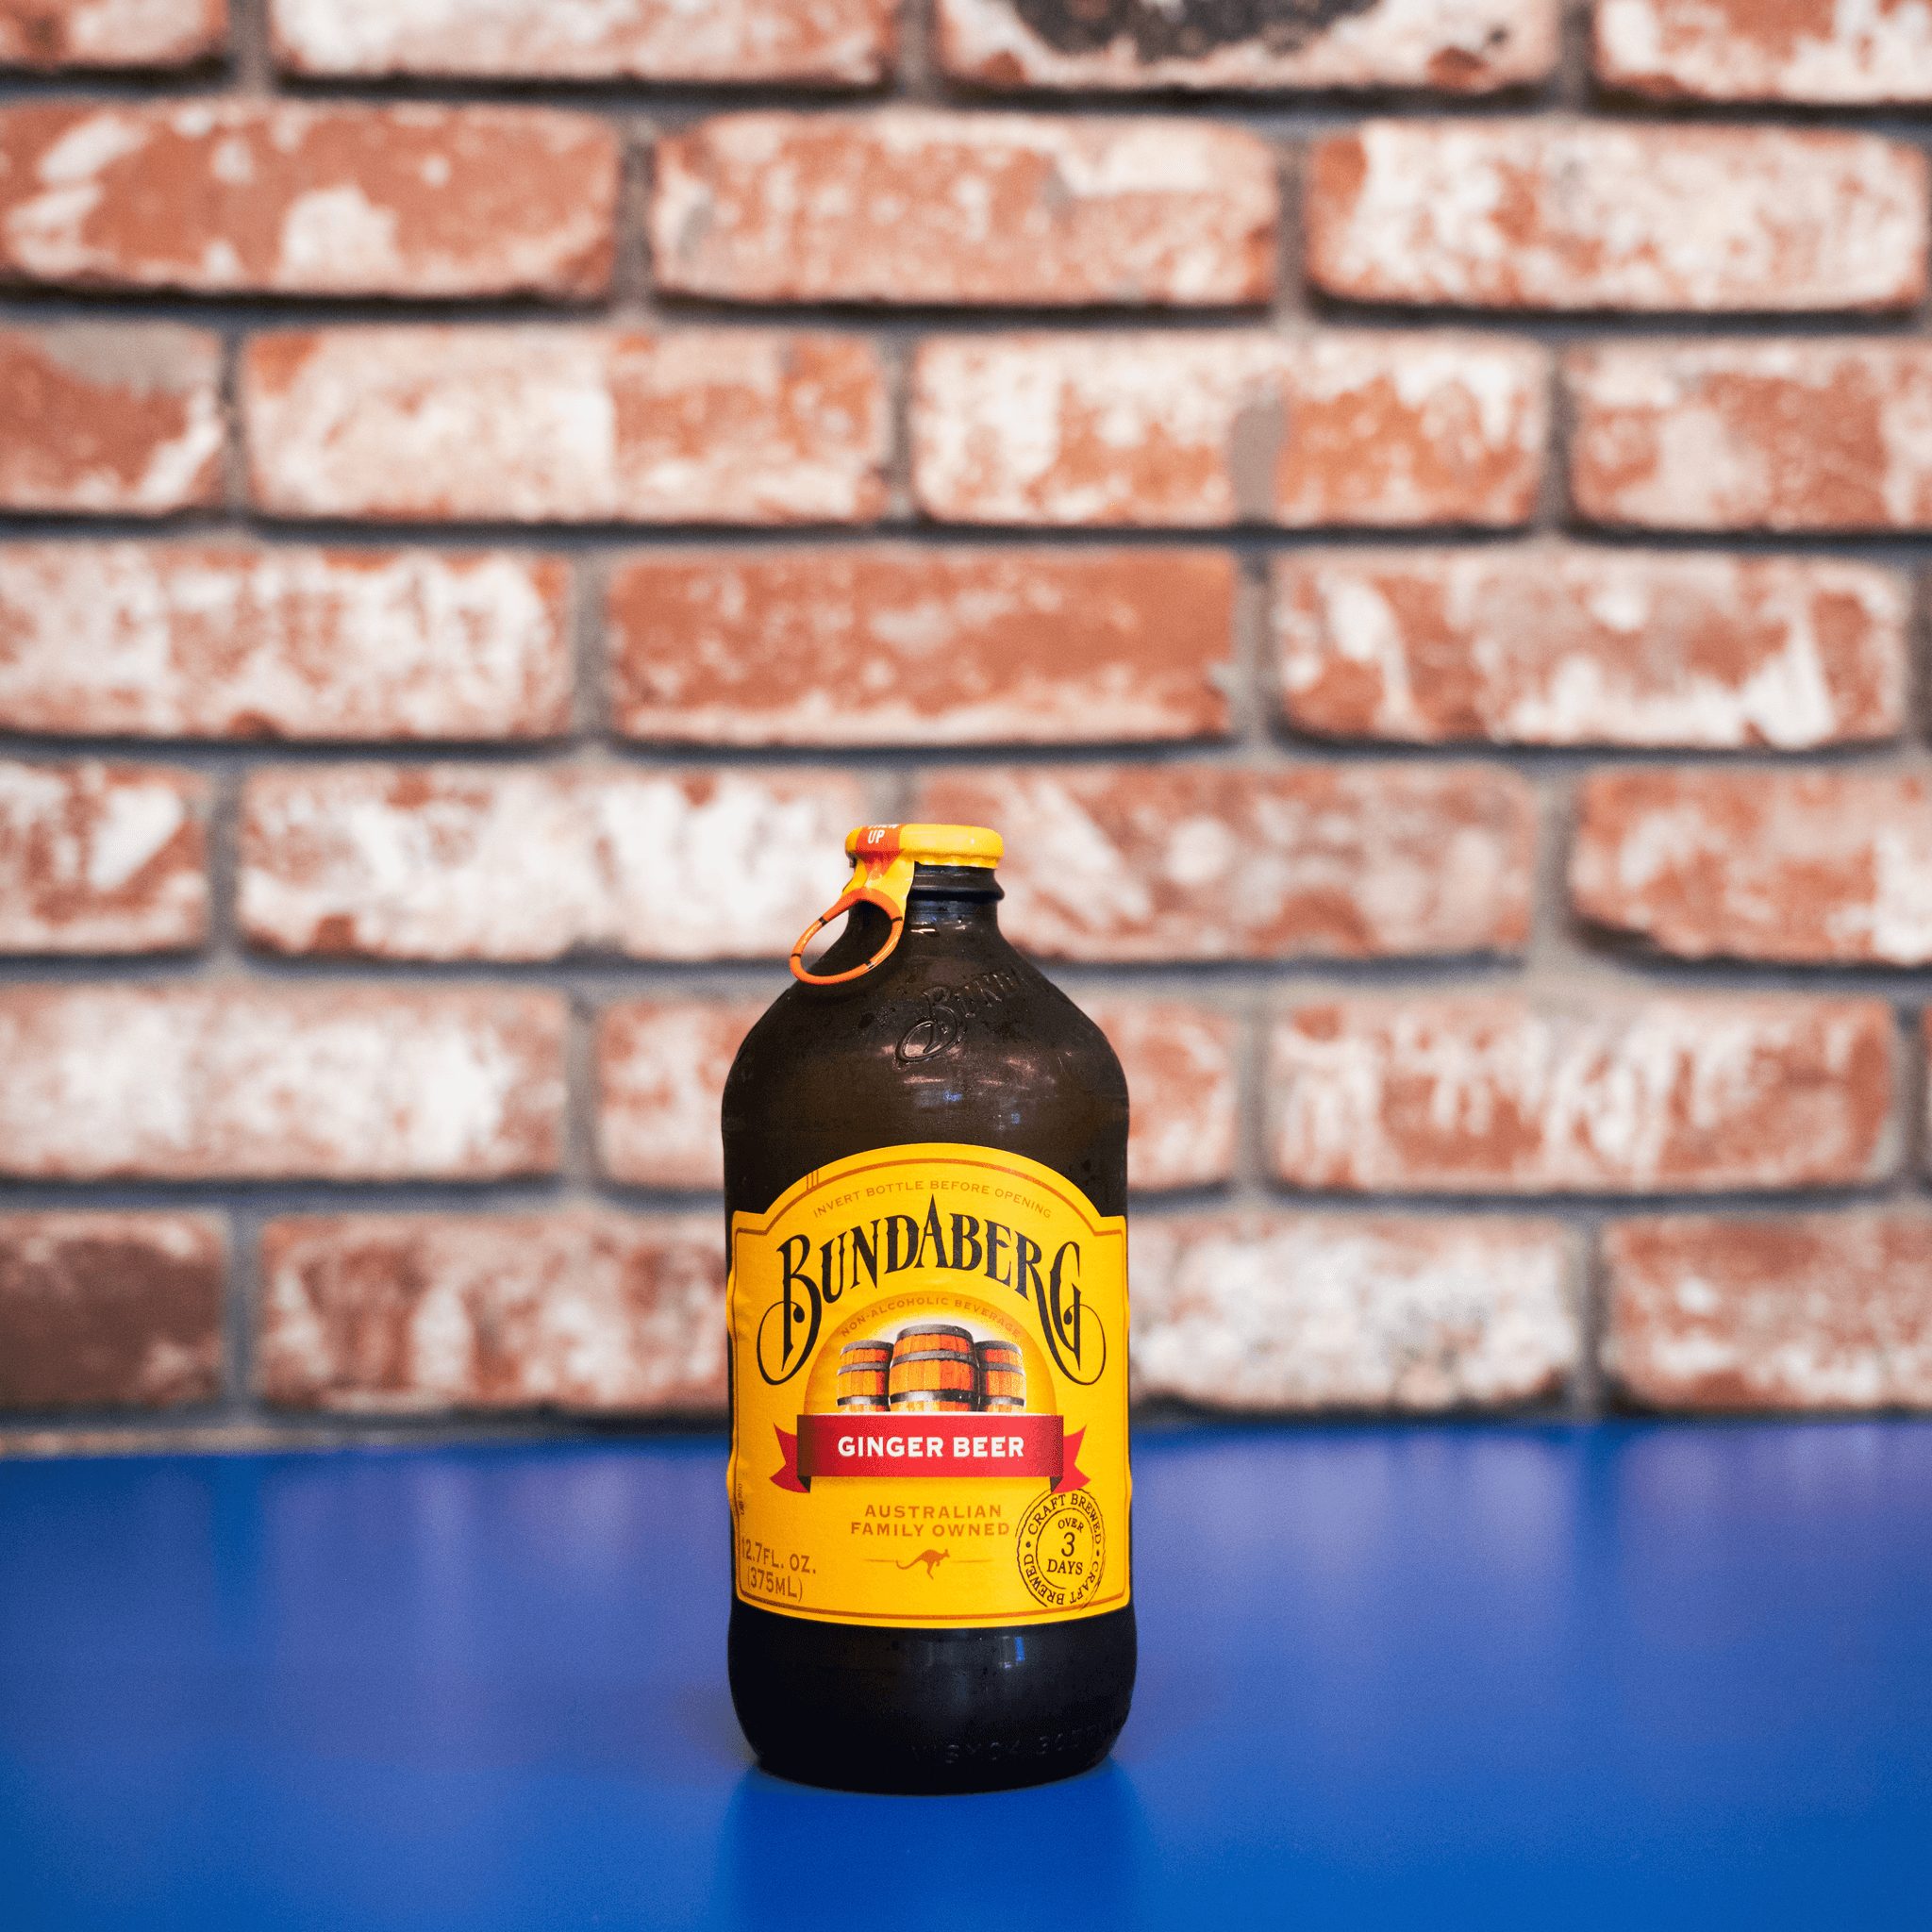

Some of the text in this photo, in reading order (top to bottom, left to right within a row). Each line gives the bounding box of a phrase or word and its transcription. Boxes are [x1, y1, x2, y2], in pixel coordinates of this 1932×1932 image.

[867, 829, 886, 844] UP
[813, 1180, 1052, 1219] INVERT BOTTLE BEFORE OPENING
[757, 1193, 1107, 1386] BUNDABERG
[841, 1297, 1021, 1338] NON-ALCOHOLIC BEVERAGE
[838, 1436, 1024, 1457] GINGER BEER
[865, 1504, 1002, 1519] AUSTRALIAN
[1027, 1492, 1102, 1545] CRAFT BREWED
[851, 1522, 1010, 1538] FAMILY OWNED
[1058, 1517, 1085, 1534] OVER
[1060, 1531, 1075, 1557] 3
[789, 1553, 816, 1574] OZ.
[1046, 1558, 1084, 1576] DAYS
[1024, 1554, 1099, 1606] CRAFT BREWED
